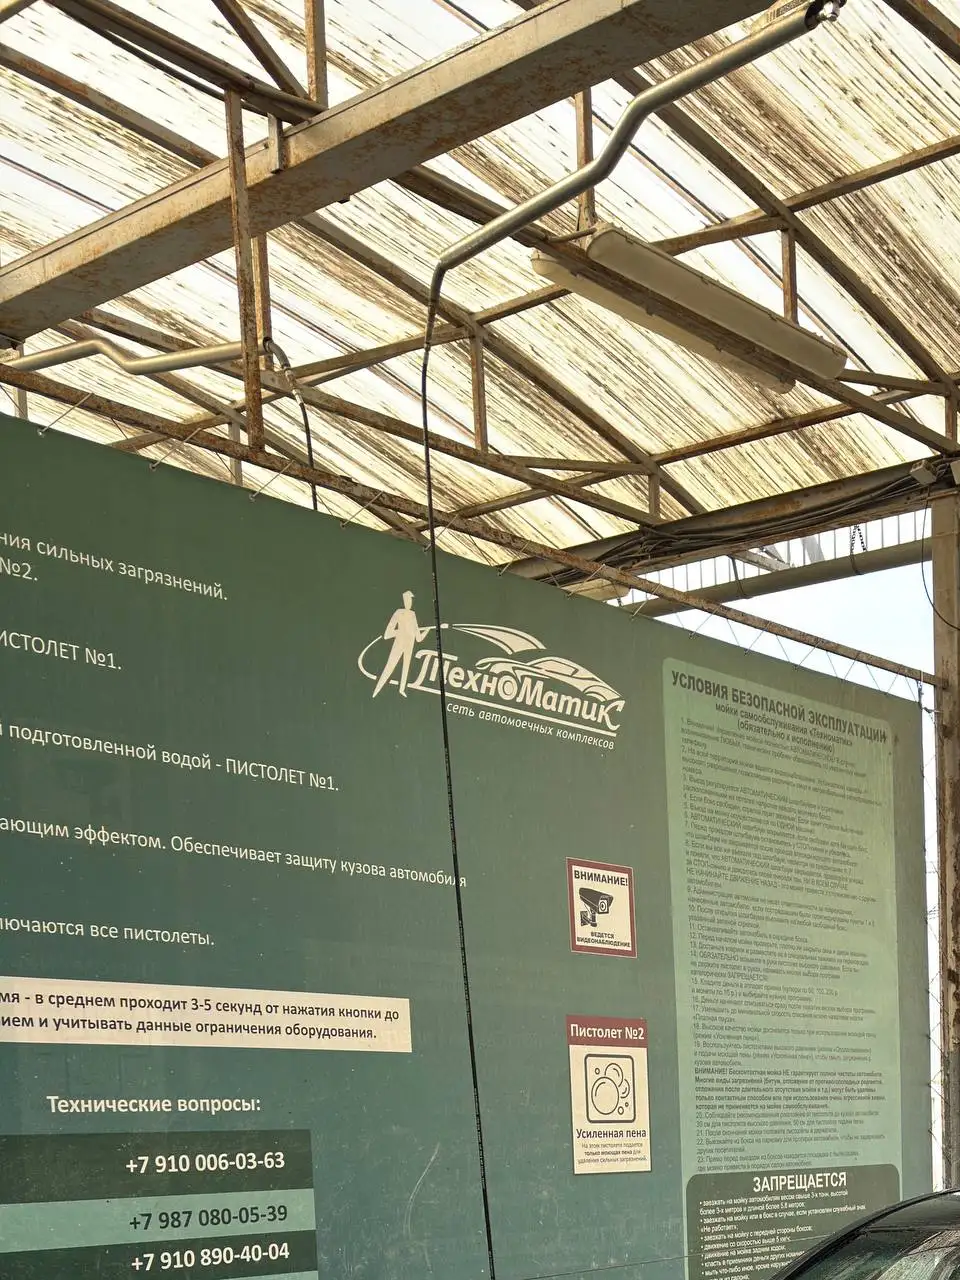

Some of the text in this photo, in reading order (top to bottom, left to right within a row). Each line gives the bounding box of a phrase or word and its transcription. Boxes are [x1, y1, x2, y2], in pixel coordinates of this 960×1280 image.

[0, 556, 38, 581] №2.
[36, 542, 114, 572] сильных
[118, 561, 229, 601] загрязнений.
[85, 647, 122, 670] №1.
[671, 669, 887, 745] УСЛОВИЯ БЕЗОПАСНОЙ ЭКСПЛУАТАЦИИ
[446, 702, 615, 751] сеть автомоечных комплексов
[715, 701, 737, 716] мойки
[740, 708, 807, 737] самообслуживания
[737, 719, 784, 741] (обязательно
[9, 725, 157, 761] подготовленной
[161, 747, 212, 771] водой
[225, 758, 305, 786] ПИСТОЛЕТ
[308, 771, 340, 792] №1.
[74, 824, 167, 853] эффектом.
[170, 834, 281, 864] Обеспечивает
[285, 852, 337, 874] защиту
[340, 860, 387, 877] кузова
[574, 870, 629, 887] ВНИМАНИЕ!
[90, 923, 119, 939] все
[123, 925, 215, 946] пистолеты.
[577, 937, 631, 948] ВИДЕОНАБЛЮДЕНИЕ
[591, 931, 615, 939] ВЕДЕТСЯ
[35, 994, 44, 1004] в
[48, 993, 116, 1010] среднем
[119, 996, 188, 1013] проходит
[190, 998, 212, 1011] 3-5
[215, 1001, 262, 1017] секунд
[264, 1004, 280, 1014] от
[282, 1005, 336, 1018] нажатия
[338, 1008, 381, 1020] кнопки
[384, 1010, 399, 1022] до
[39, 1017, 49, 1027] и
[53, 1016, 132, 1032] учитывать
[136, 1019, 192, 1034] данные
[195, 1022, 282, 1038] ограничения
[285, 1025, 377, 1040] оборудования.
[570, 1023, 645, 1040] Пистолет №2
[46, 1095, 262, 1114] Технические вопросы:
[576, 1129, 647, 1138] Усиленная пена
[126, 1151, 285, 1174] +7 910 006-03-63
[752, 1170, 846, 1194] ЗАПРЕЩАЕТСЯ
[699, 1207, 715, 1215] более
[765, 1202, 779, 1210] более
[733, 1196, 748, 1205] мойку
[129, 1205, 288, 1231] +7 987 080-05-39
[733, 1213, 748, 1222] мойку
[734, 1230, 749, 1239] мойку
[131, 1242, 289, 1272] +7 910 890-40-04
